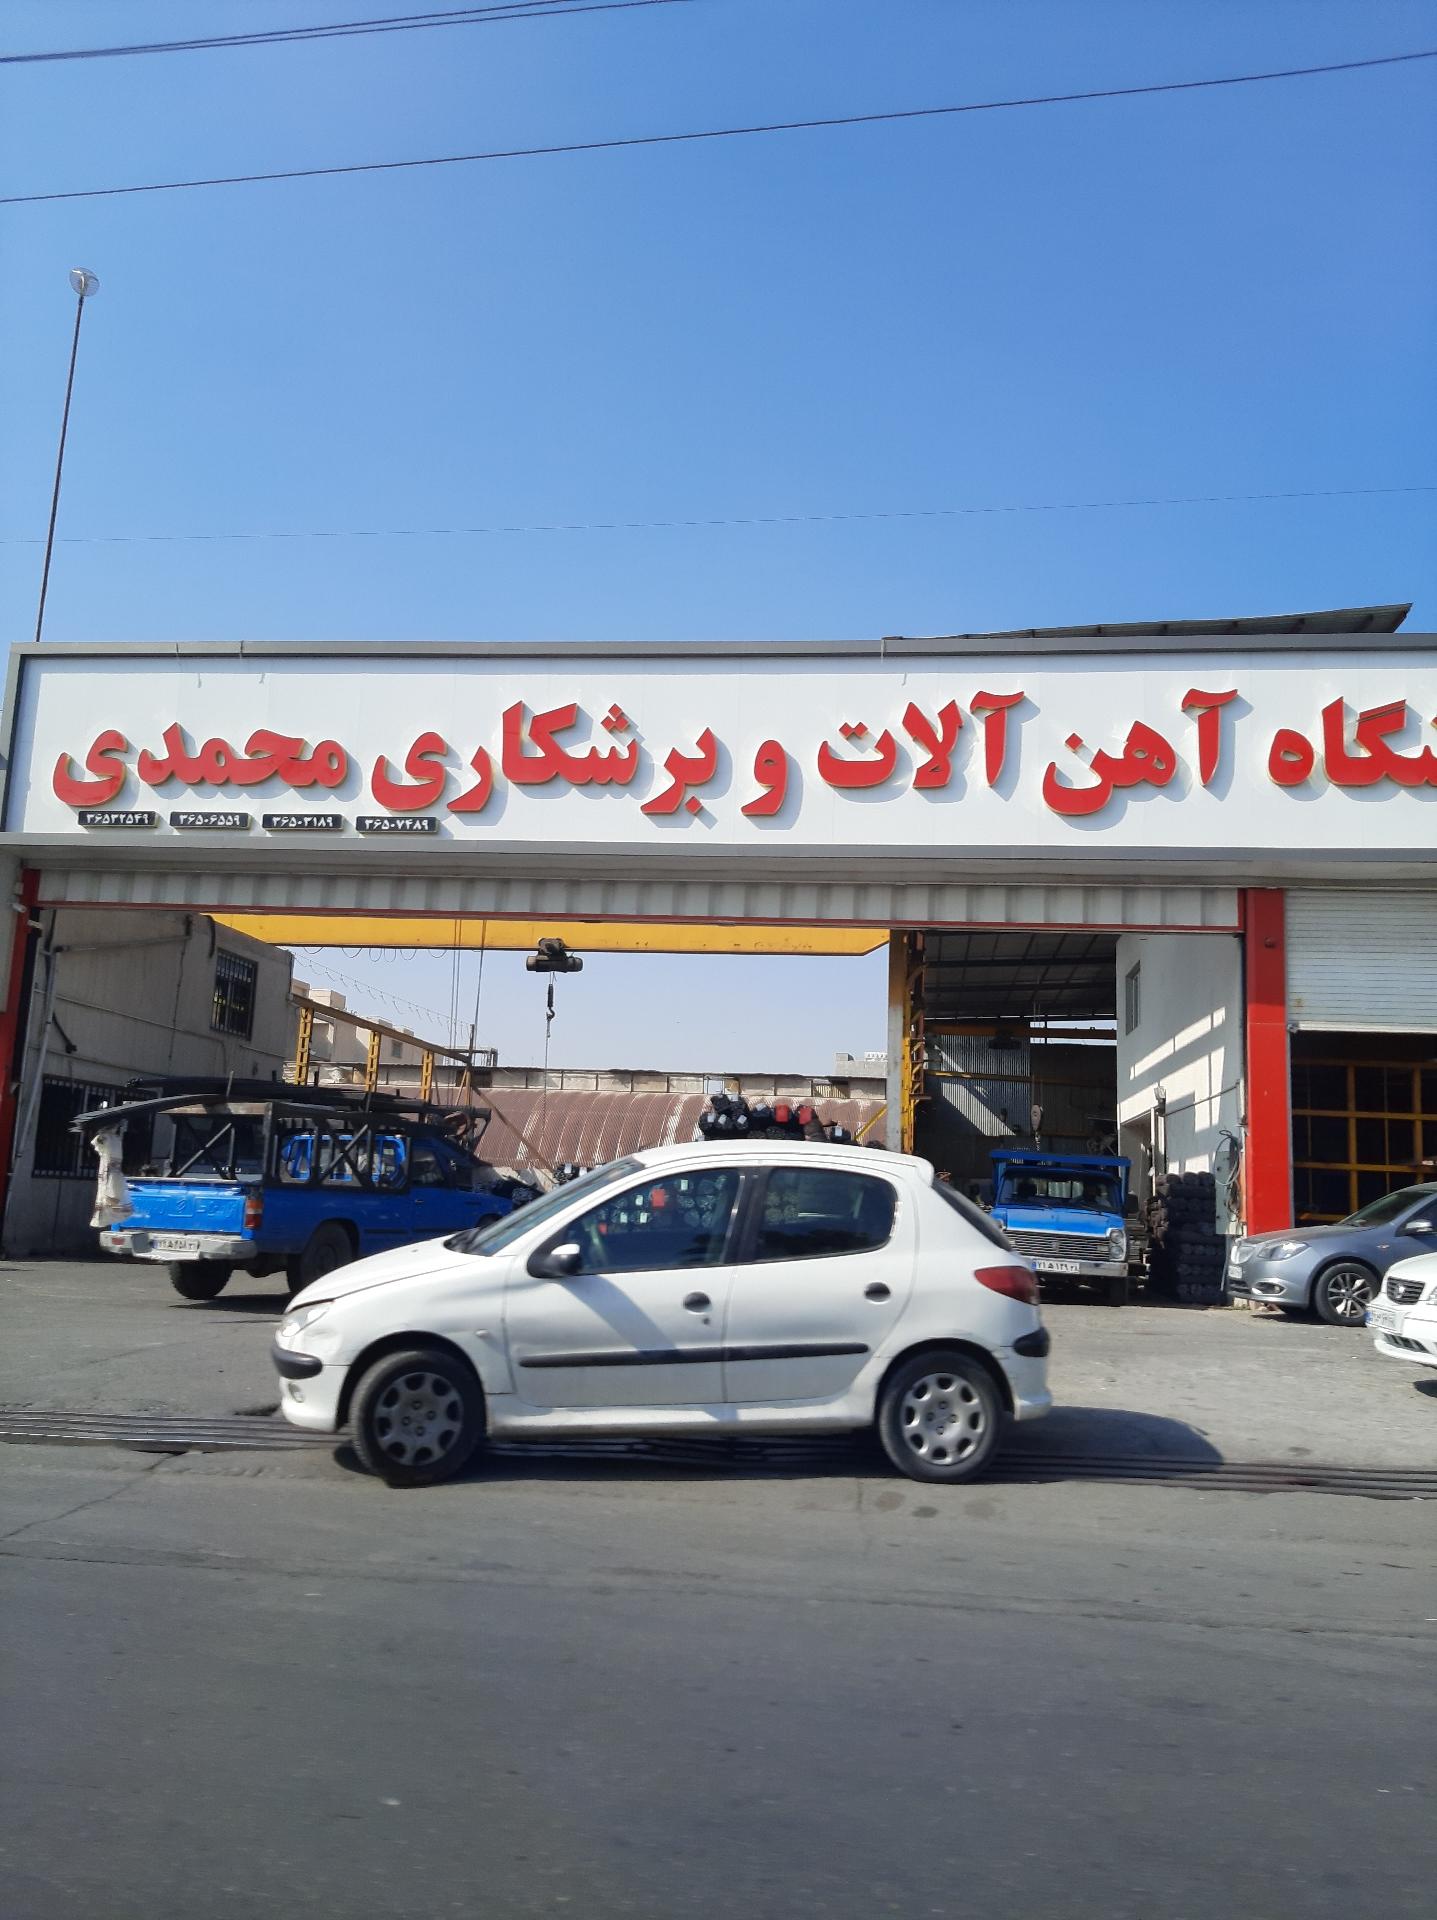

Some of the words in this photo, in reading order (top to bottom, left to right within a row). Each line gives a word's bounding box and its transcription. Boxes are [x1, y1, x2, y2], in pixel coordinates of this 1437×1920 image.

[54, 722, 346, 806] محمدی
[371, 700, 717, 812] برشکاری
[741, 740, 788, 815] و
[817, 691, 1024, 788] آلات
[1042, 689, 1238, 815] آهن
[179, 814, 240, 826] ۳۶۵۰۶۵۵۹
[364, 818, 429, 830] ۳۶۵۰۷۴۸۹
